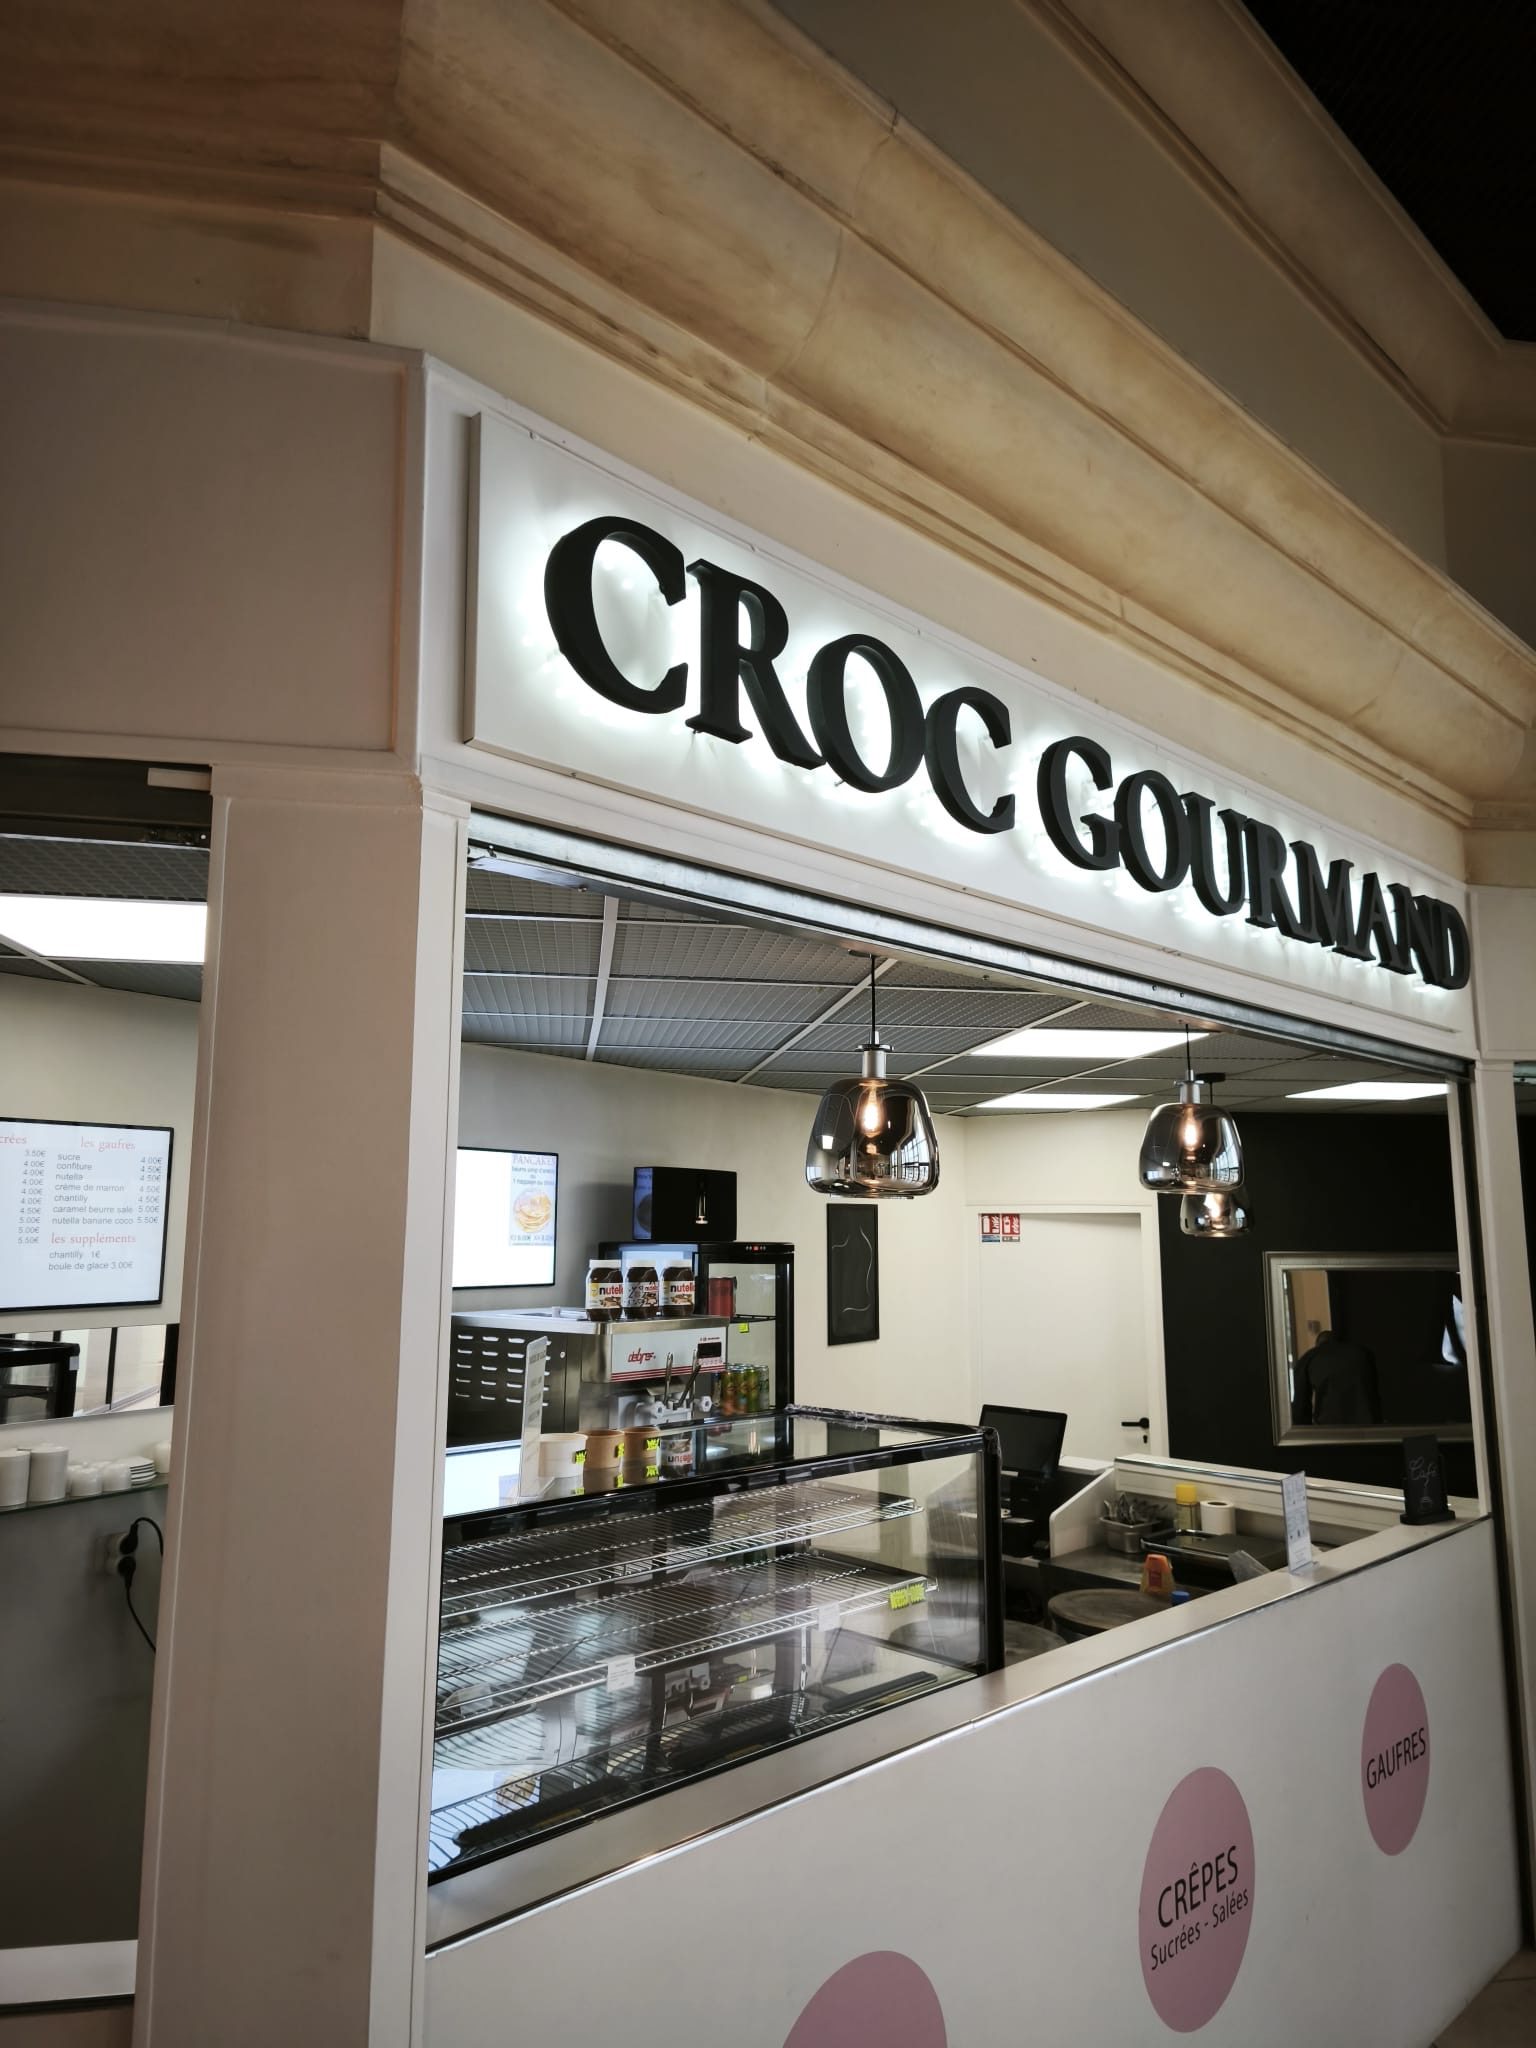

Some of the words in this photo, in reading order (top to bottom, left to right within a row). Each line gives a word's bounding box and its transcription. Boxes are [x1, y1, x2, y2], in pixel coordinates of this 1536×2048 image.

[544, 516, 1015, 834] CROC
[1037, 736, 1470, 989] GOURMAND
[57, 1153, 81, 1161] sucre
[56, 1162, 92, 1170] confiture
[55, 1173, 83, 1181] nutella
[95, 1184, 124, 1192] marron
[54, 1194, 88, 1203] chantilly
[52, 1205, 87, 1213] caramel
[52, 1216, 80, 1225] nutella
[82, 1217, 112, 1225] banane
[114, 1217, 133, 1225] coco
[51, 1233, 66, 1243] les
[49, 1251, 83, 1259] chantilly
[48, 1262, 72, 1270] boule
[86, 1261, 109, 1271] glace
[1366, 1728, 1427, 1789] GAUFRES
[1157, 1845, 1238, 1928] CRÊPES
[1150, 1921, 1202, 1971] Sucrées
[1212, 1888, 1249, 1929] Salées
